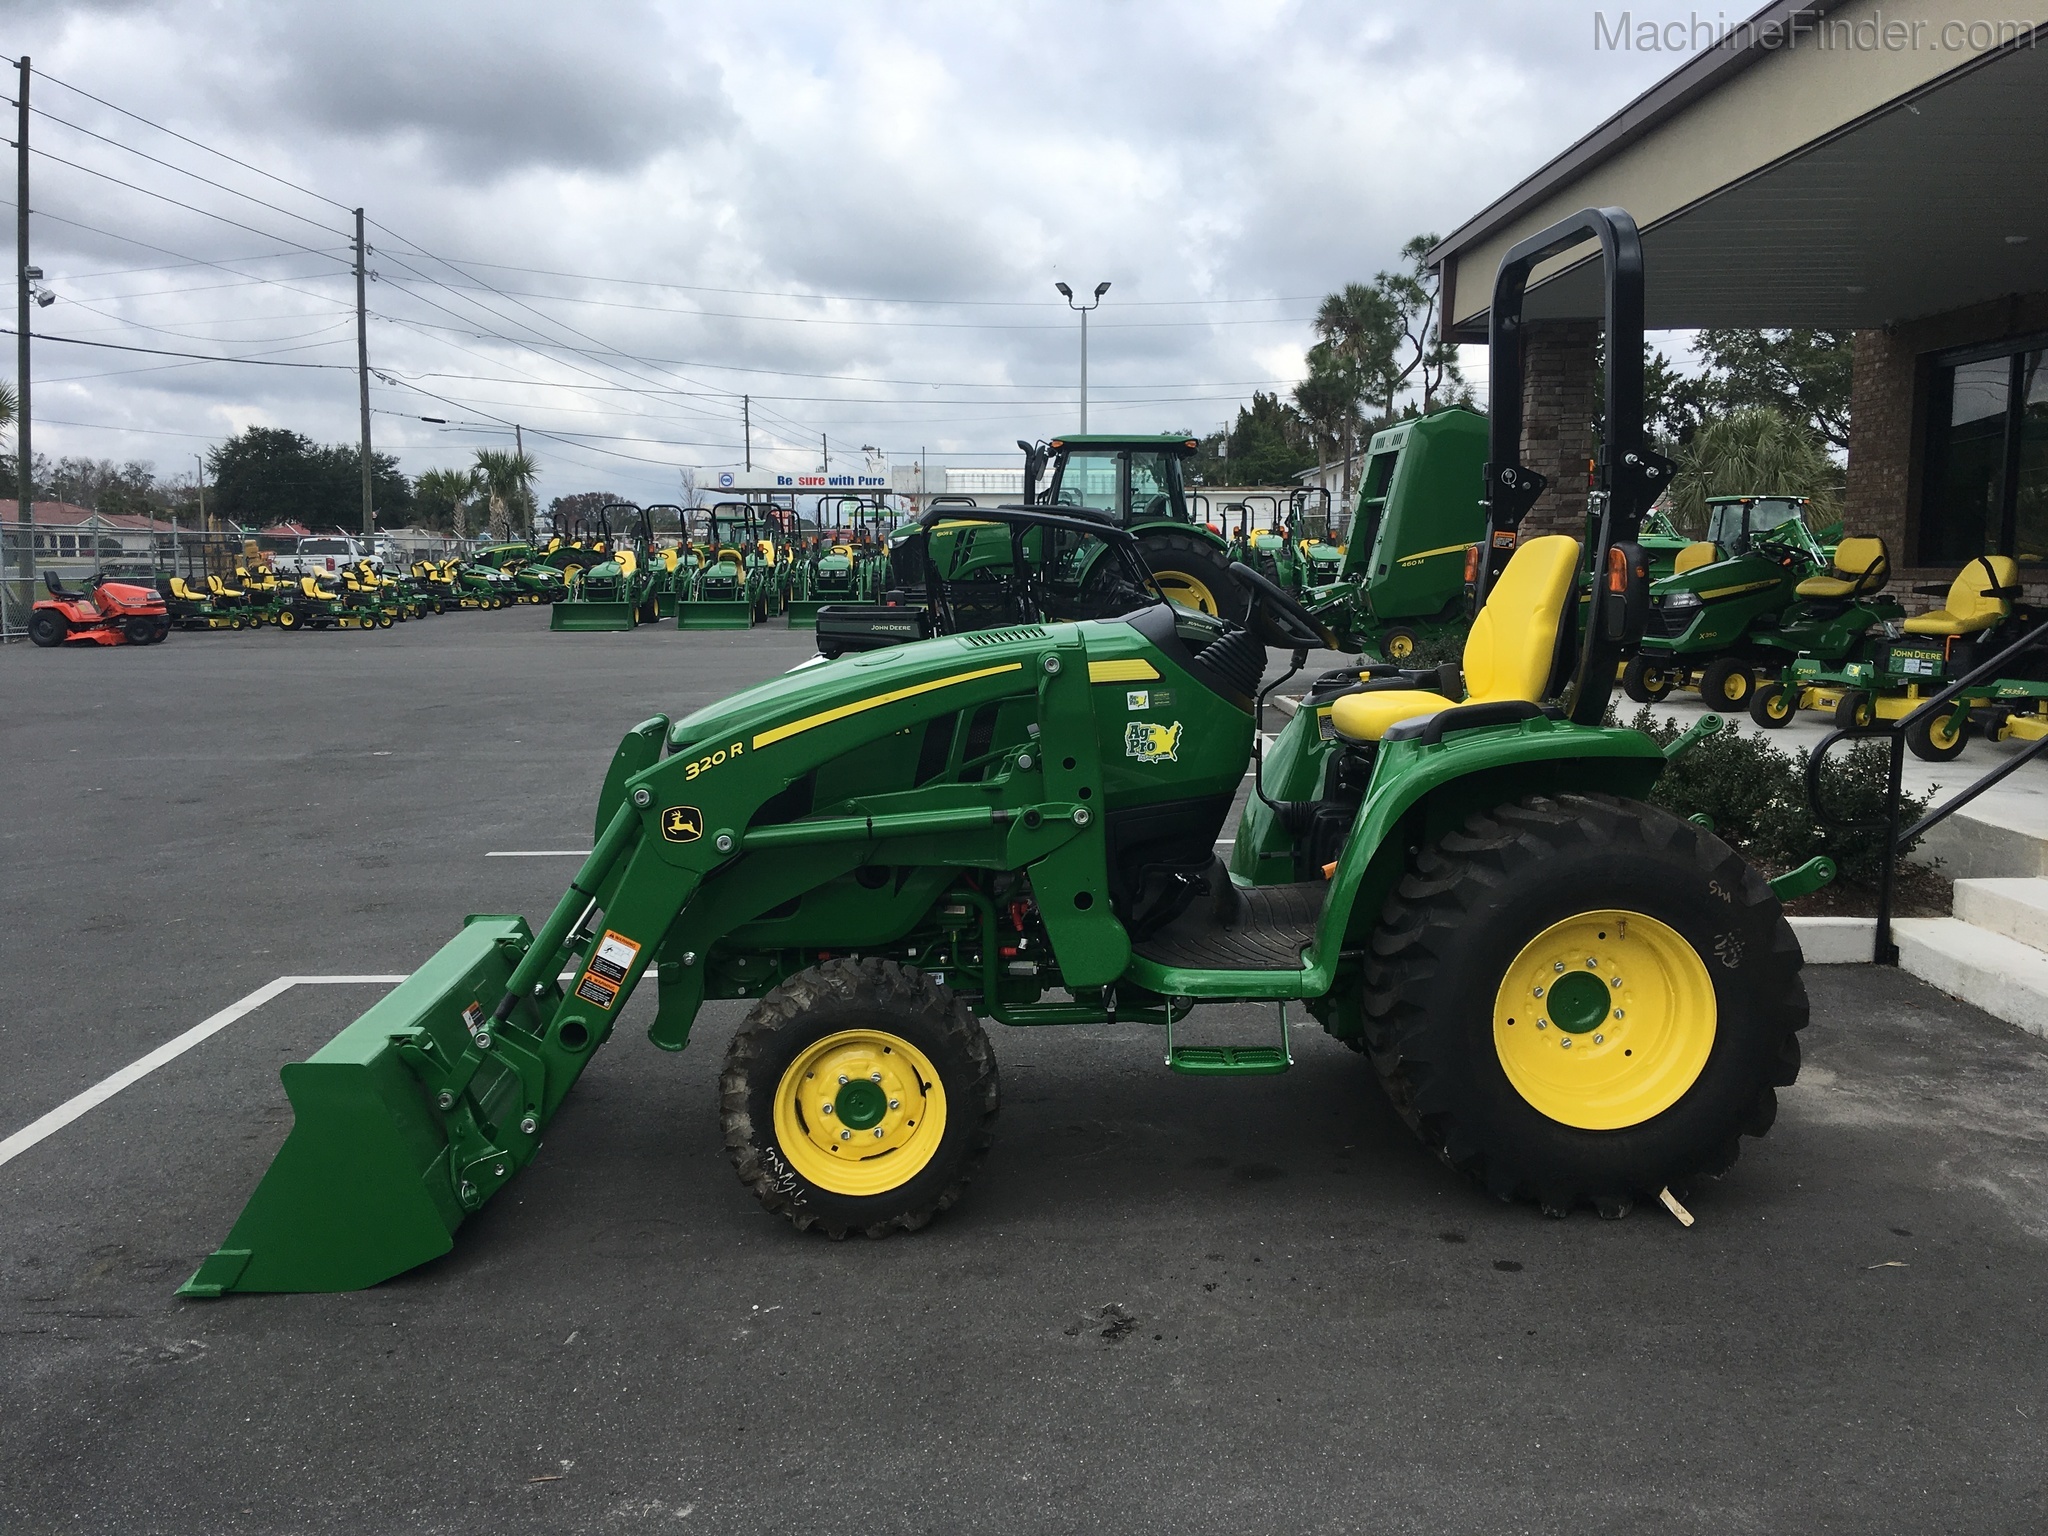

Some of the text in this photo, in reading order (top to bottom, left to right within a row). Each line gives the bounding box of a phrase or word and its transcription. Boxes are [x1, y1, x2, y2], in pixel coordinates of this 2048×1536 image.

[777, 474, 885, 486] Be sure with Pure
[1401, 560, 1417, 568] 460
[1891, 649, 1943, 661] JOHN DEERE
[1128, 725, 1155, 741] Ag-
[1129, 740, 1156, 754] Pro
[685, 741, 745, 782] 320 R
